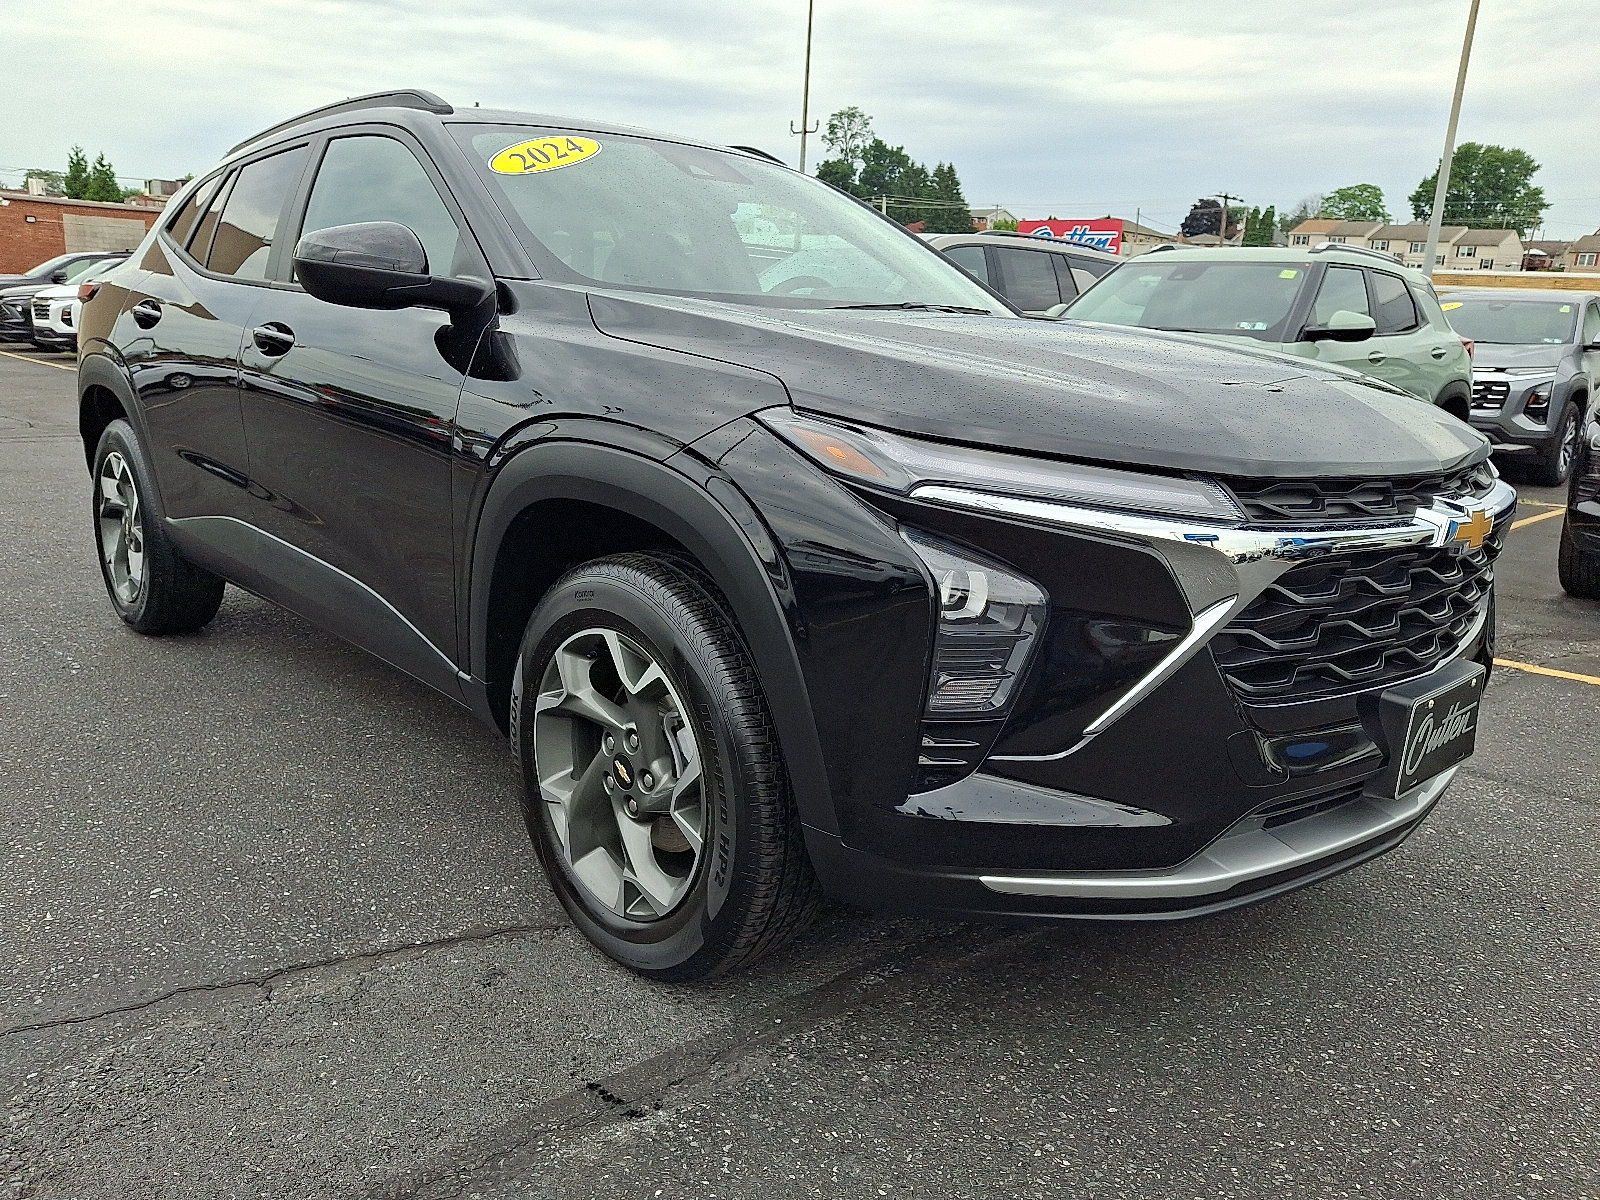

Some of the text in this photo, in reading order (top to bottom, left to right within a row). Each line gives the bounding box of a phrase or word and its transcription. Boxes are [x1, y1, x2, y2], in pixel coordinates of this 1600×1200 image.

[508, 137, 584, 171] 2024
[1405, 700, 1478, 776] Outten
[713, 832, 731, 890] HP2
